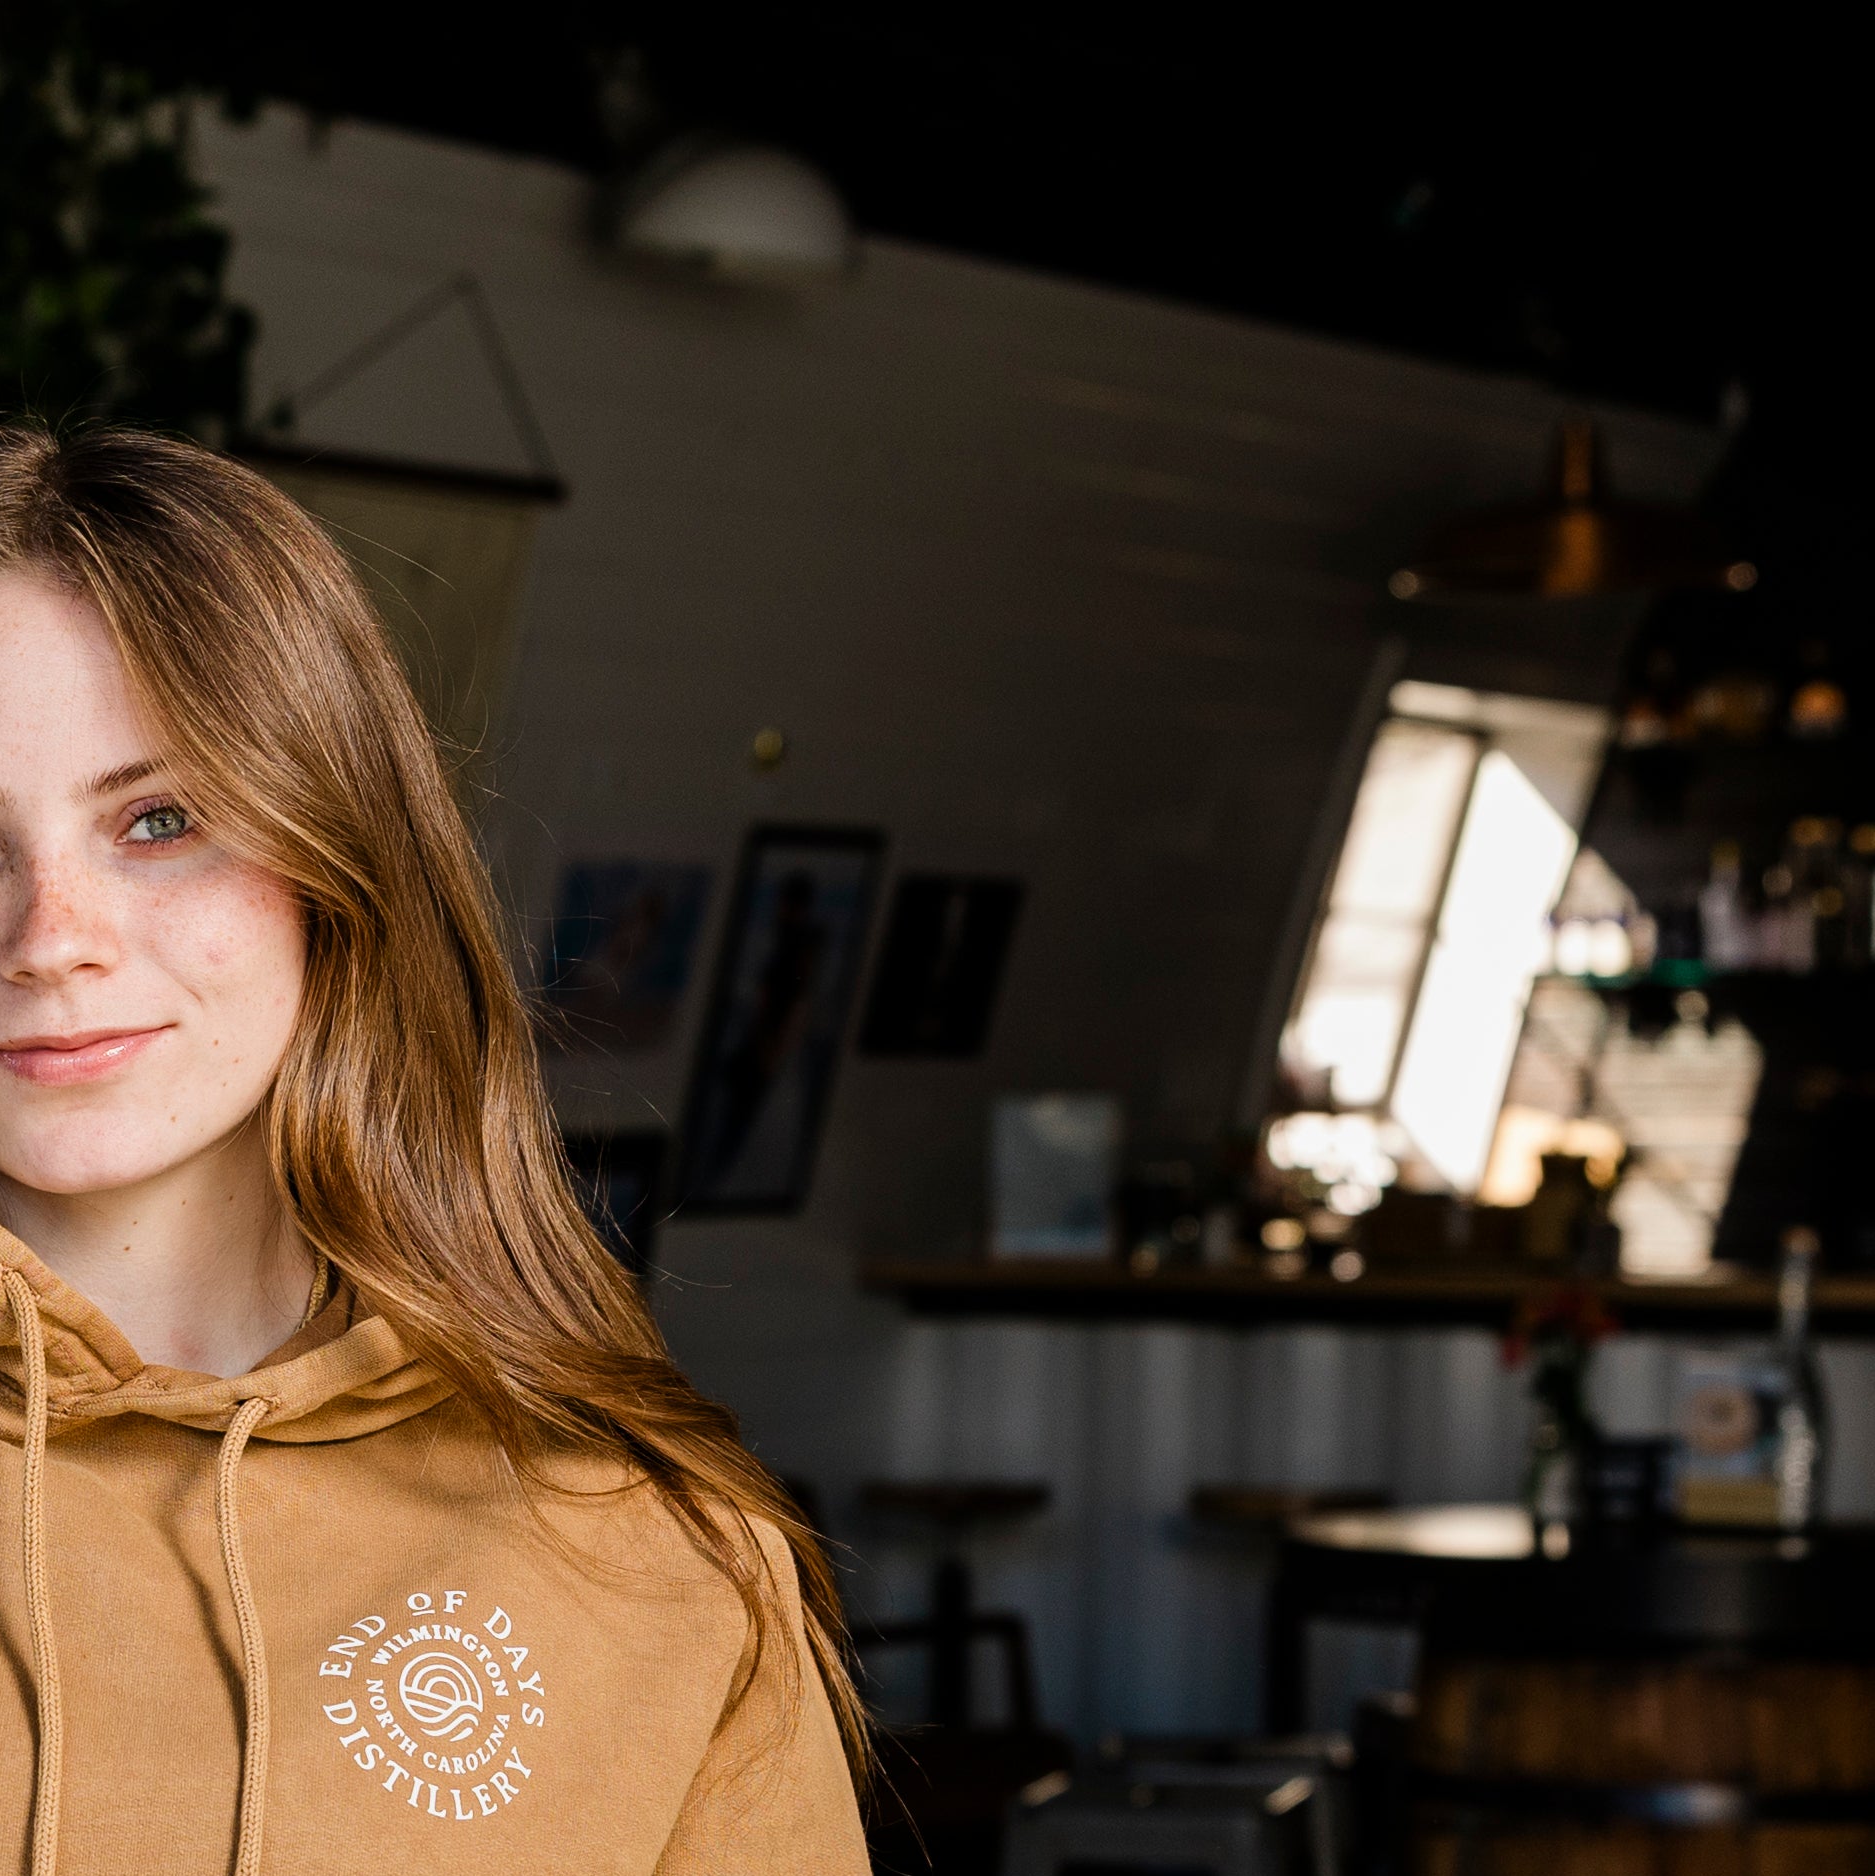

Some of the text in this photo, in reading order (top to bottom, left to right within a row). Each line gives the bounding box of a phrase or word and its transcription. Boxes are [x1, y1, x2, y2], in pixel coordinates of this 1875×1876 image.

[318, 1590, 545, 1728] END OF DAYS
[370, 1624, 510, 1697] WILMINGTON
[322, 1698, 532, 1821] DISTILLERY
[365, 1678, 511, 1775] NORTH CAROLINA
